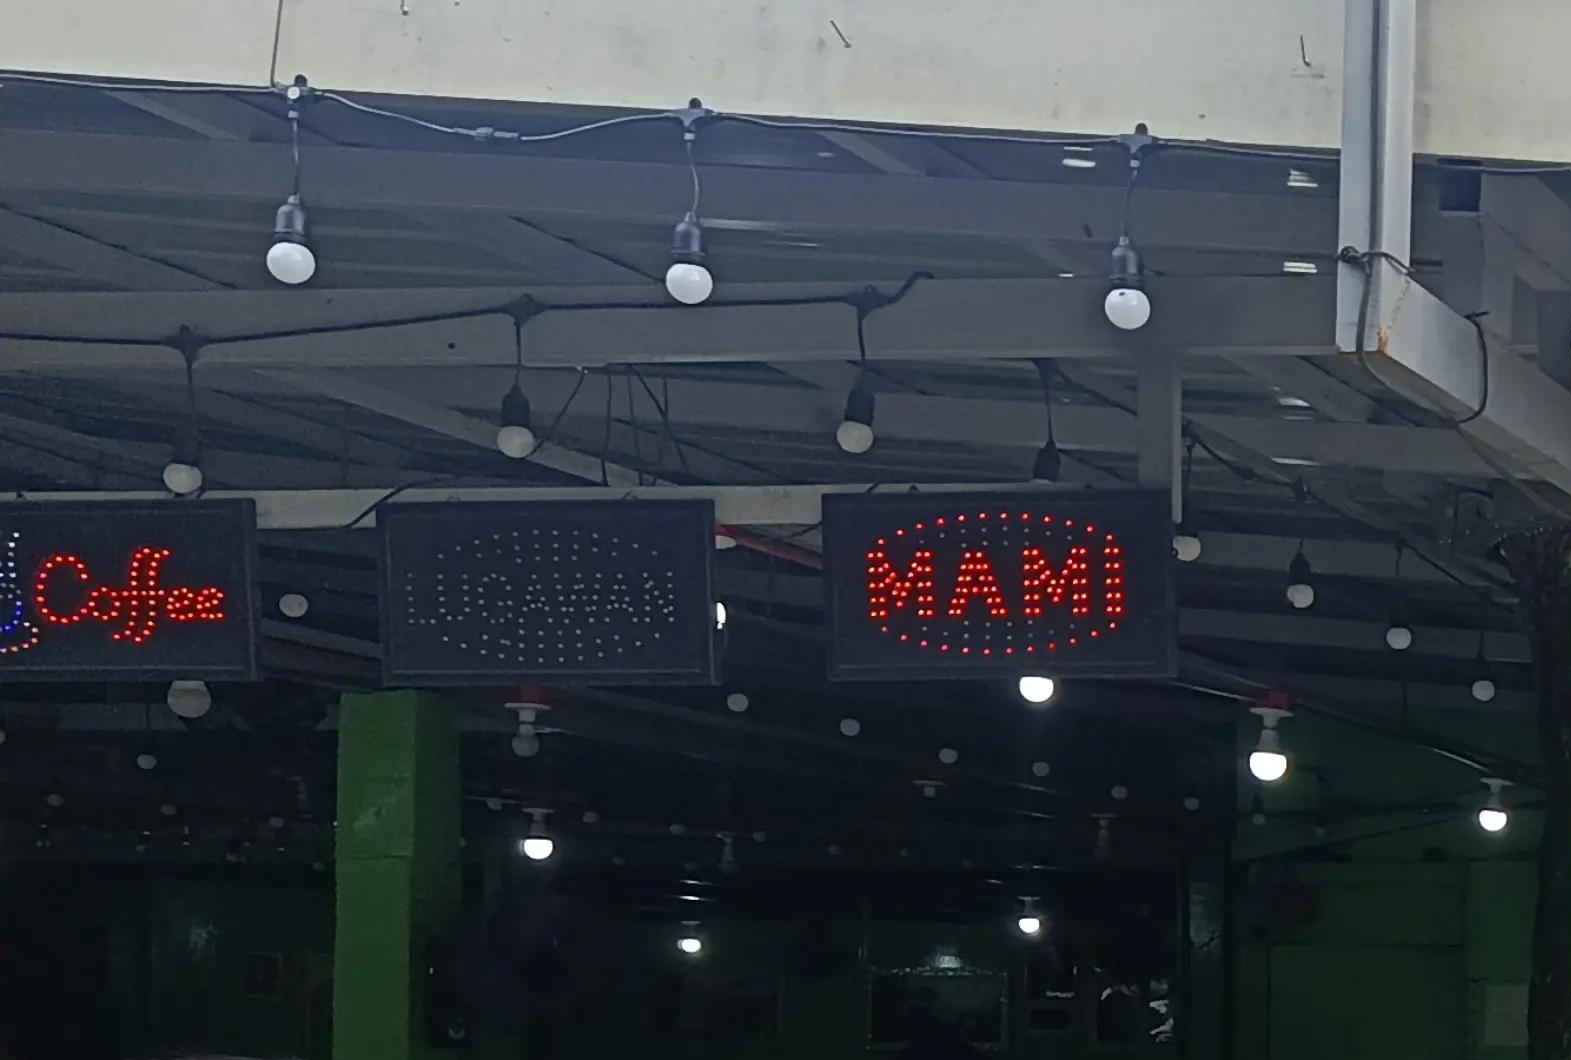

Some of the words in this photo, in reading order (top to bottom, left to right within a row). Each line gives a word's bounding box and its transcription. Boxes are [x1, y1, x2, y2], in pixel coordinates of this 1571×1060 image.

[35, 548, 226, 643] Coffee
[406, 572, 674, 624] LUGAWAN
[866, 548, 1124, 618] MAMI
